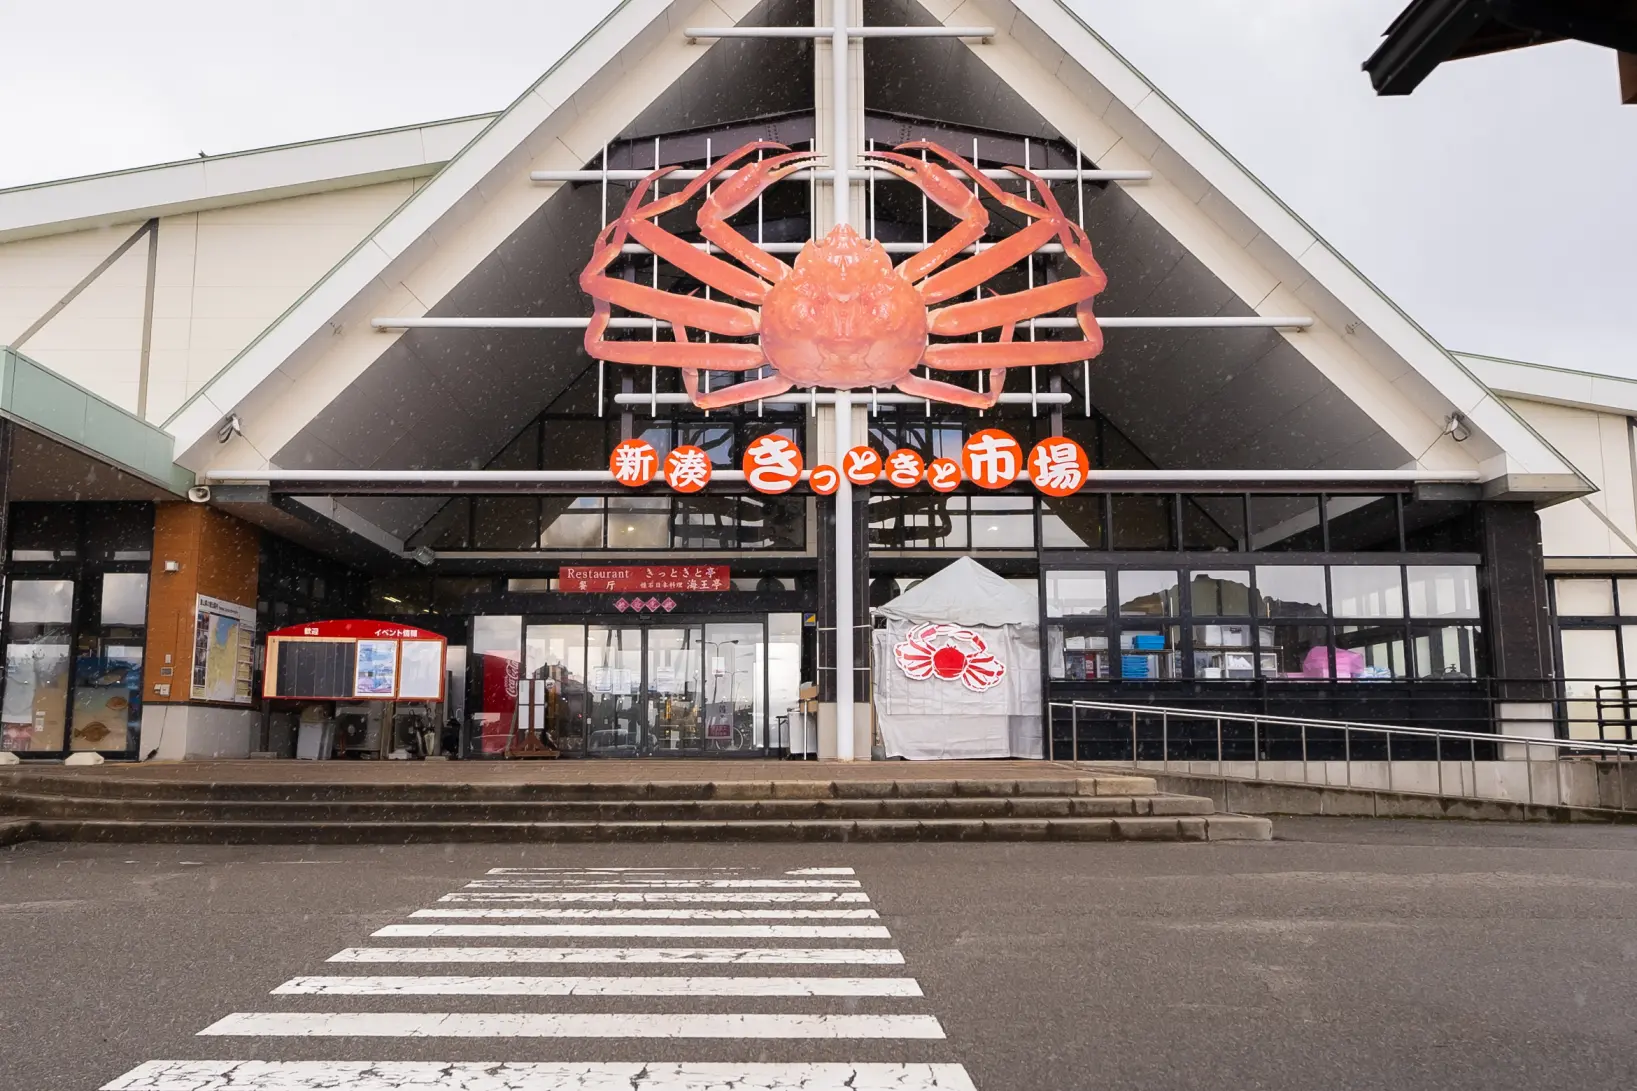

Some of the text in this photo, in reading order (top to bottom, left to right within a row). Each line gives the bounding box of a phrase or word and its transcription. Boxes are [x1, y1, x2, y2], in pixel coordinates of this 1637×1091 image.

[614, 433, 1081, 490] 新湊きっときと市場
[567, 568, 630, 580] Restaurant
[686, 578, 723, 591] 海王亭
